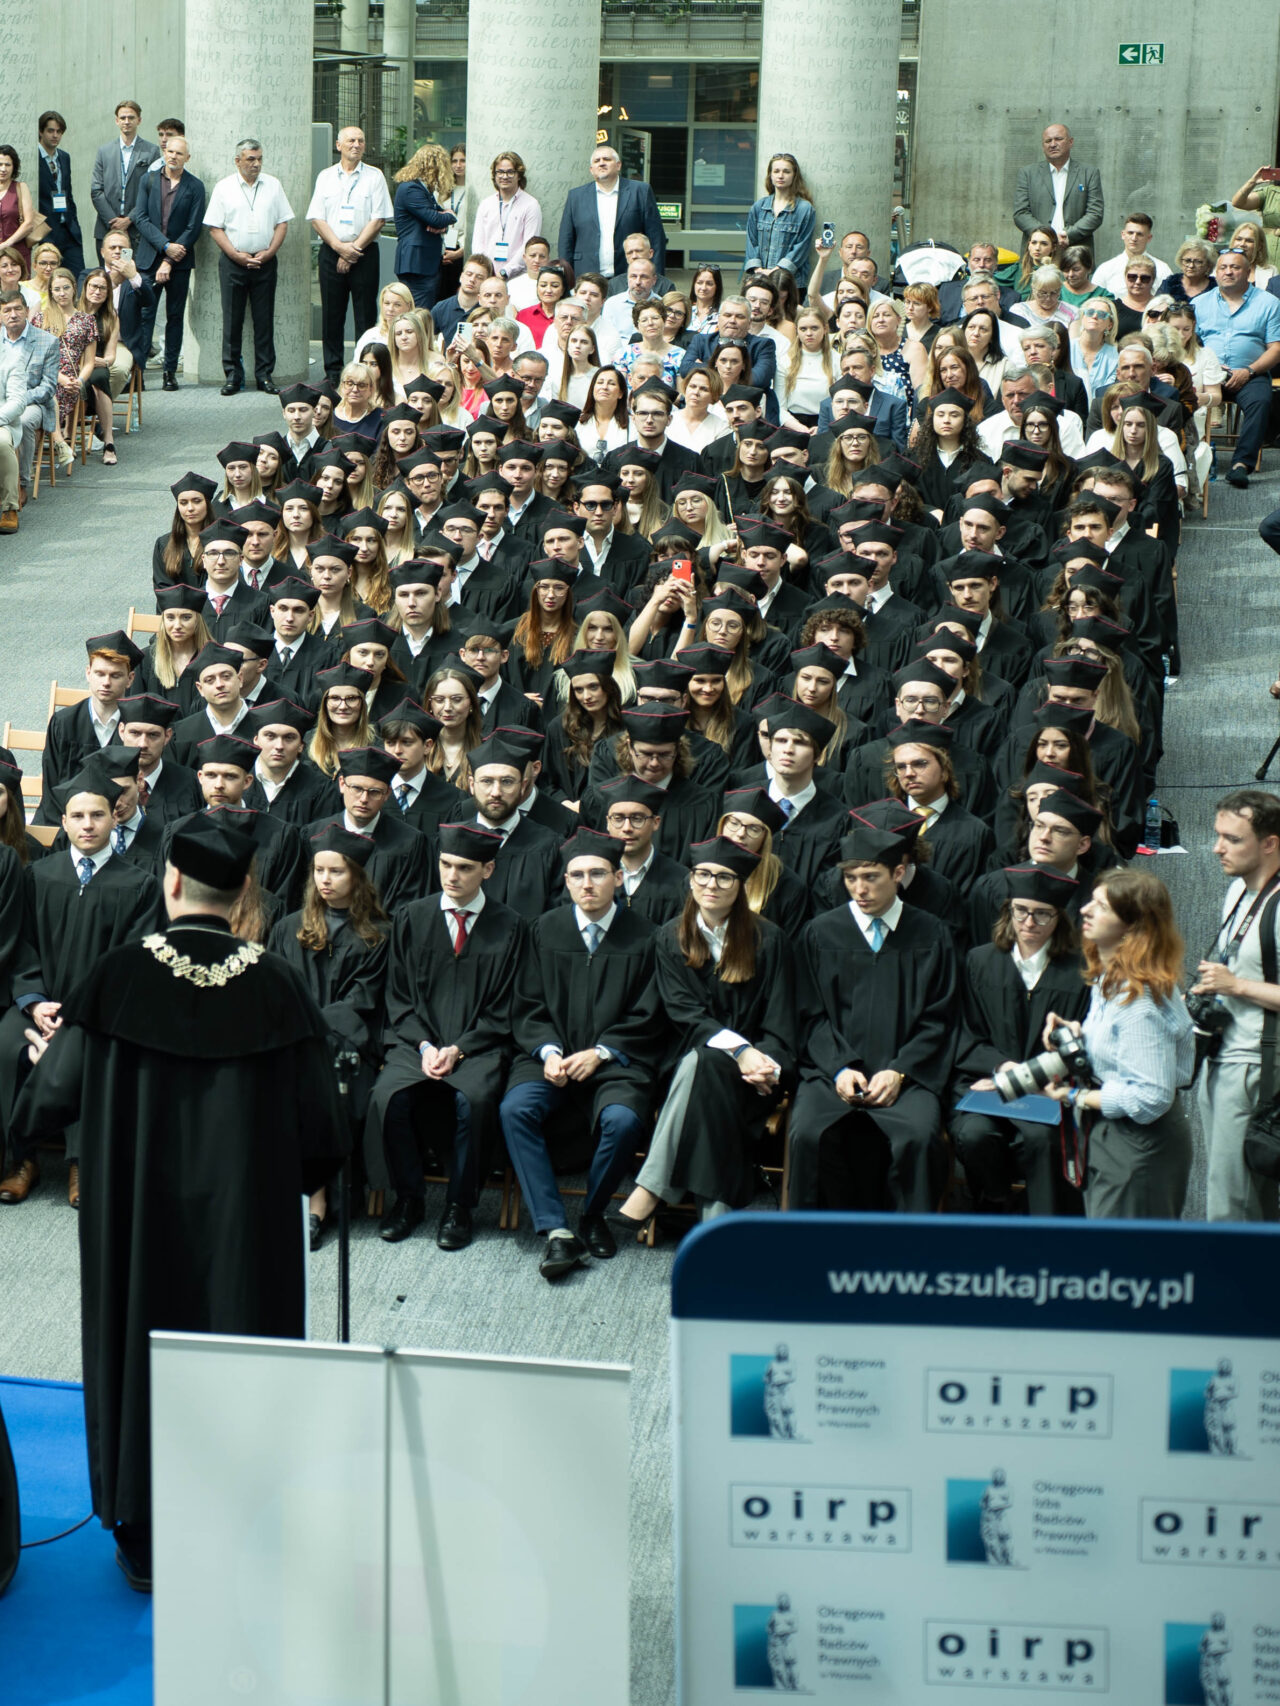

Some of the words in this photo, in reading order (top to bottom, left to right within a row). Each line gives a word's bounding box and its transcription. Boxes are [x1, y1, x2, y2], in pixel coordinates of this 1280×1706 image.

[828, 1266, 1194, 1310] www.szukajradcy.pl
[938, 1376, 1098, 1414] oirp
[816, 1402, 880, 1418] Prawnych
[939, 1414, 1097, 1432] warszawa
[742, 1490, 897, 1528] oirp
[743, 1529, 897, 1546] warszawa
[1033, 1529, 1098, 1545] Prawnych
[937, 1628, 1095, 1668] oirp
[817, 1653, 880, 1669] Prawnych
[939, 1667, 1094, 1686] warszawa
